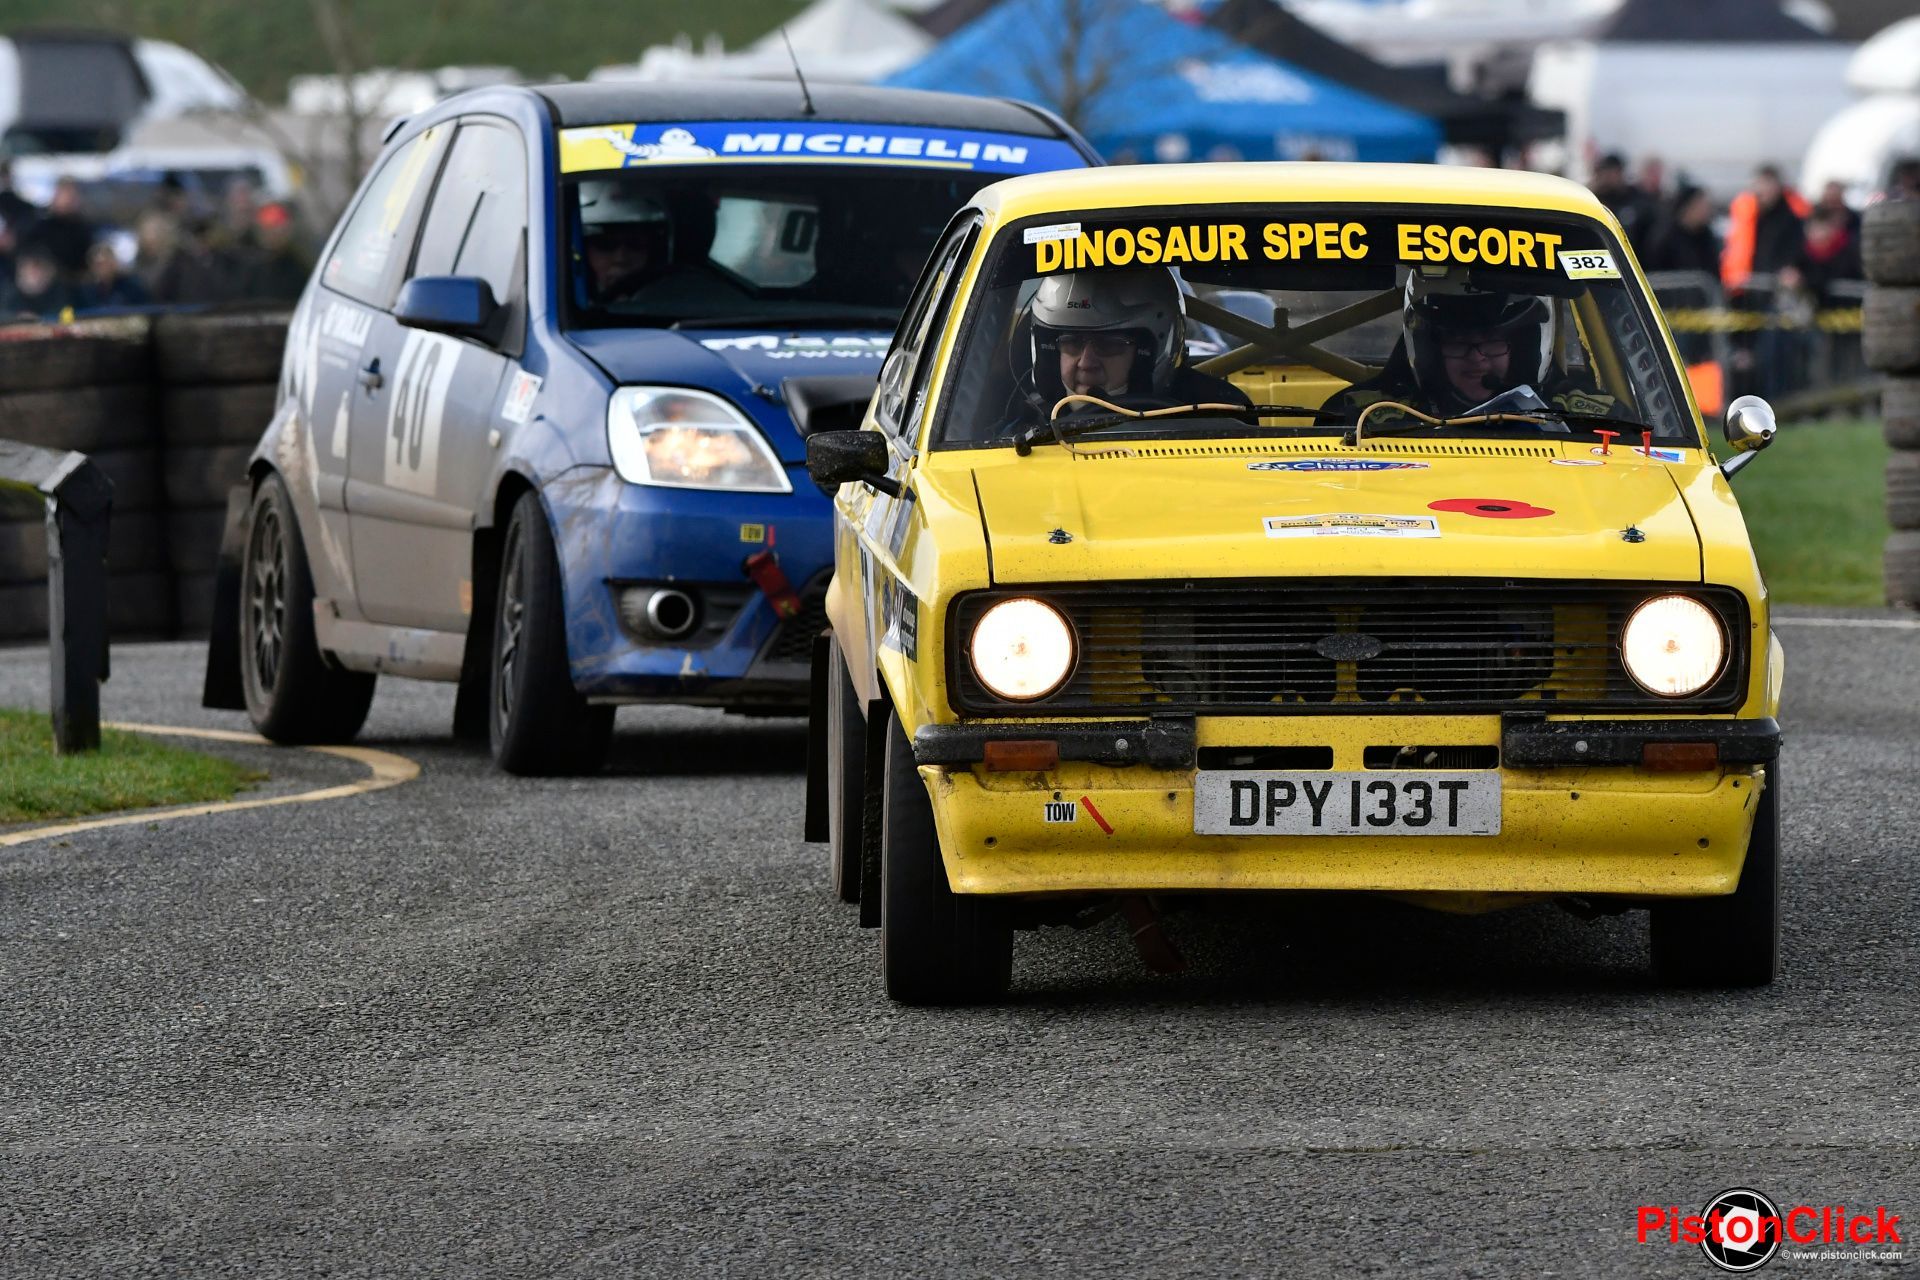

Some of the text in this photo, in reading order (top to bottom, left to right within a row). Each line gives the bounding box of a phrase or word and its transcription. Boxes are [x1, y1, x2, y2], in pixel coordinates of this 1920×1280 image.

[722, 133, 1028, 163] MICHELIN
[1035, 223, 1563, 273] DINOSAUR SPEC ESCORT
[1568, 256, 1608, 269] 382
[392, 336, 443, 472] 40
[1293, 462, 1381, 470] Classic
[1045, 803, 1075, 822] TOW
[1229, 780, 1470, 828] DPY 133T
